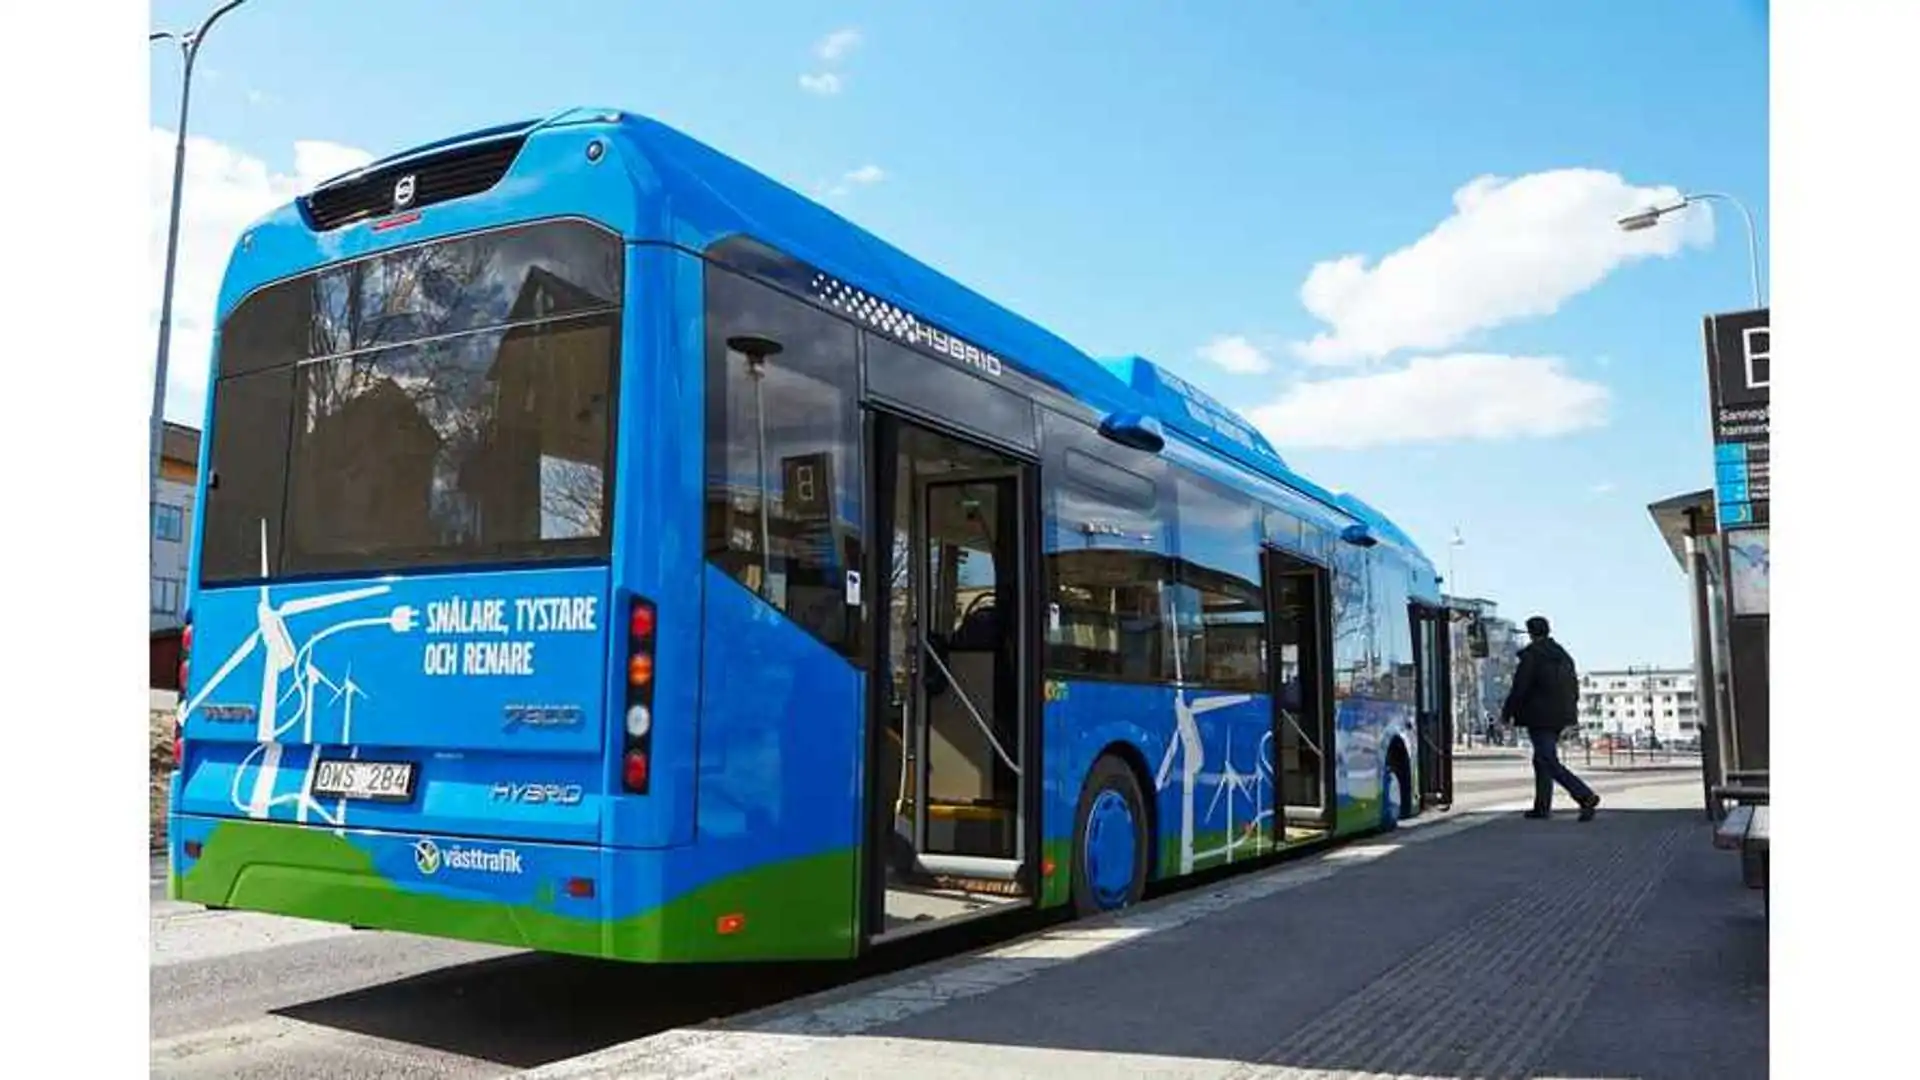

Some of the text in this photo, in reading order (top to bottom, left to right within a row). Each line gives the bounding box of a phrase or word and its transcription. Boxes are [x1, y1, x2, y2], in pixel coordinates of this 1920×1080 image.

[915, 321, 1002, 377] HYBRID
[425, 594, 598, 637] SNÅLARE, TYSTARE
[423, 641, 535, 676] OCH RENARE
[367, 765, 407, 792] 284
[488, 781, 583, 804] HYBRID
[441, 844, 524, 874] västtrafik
